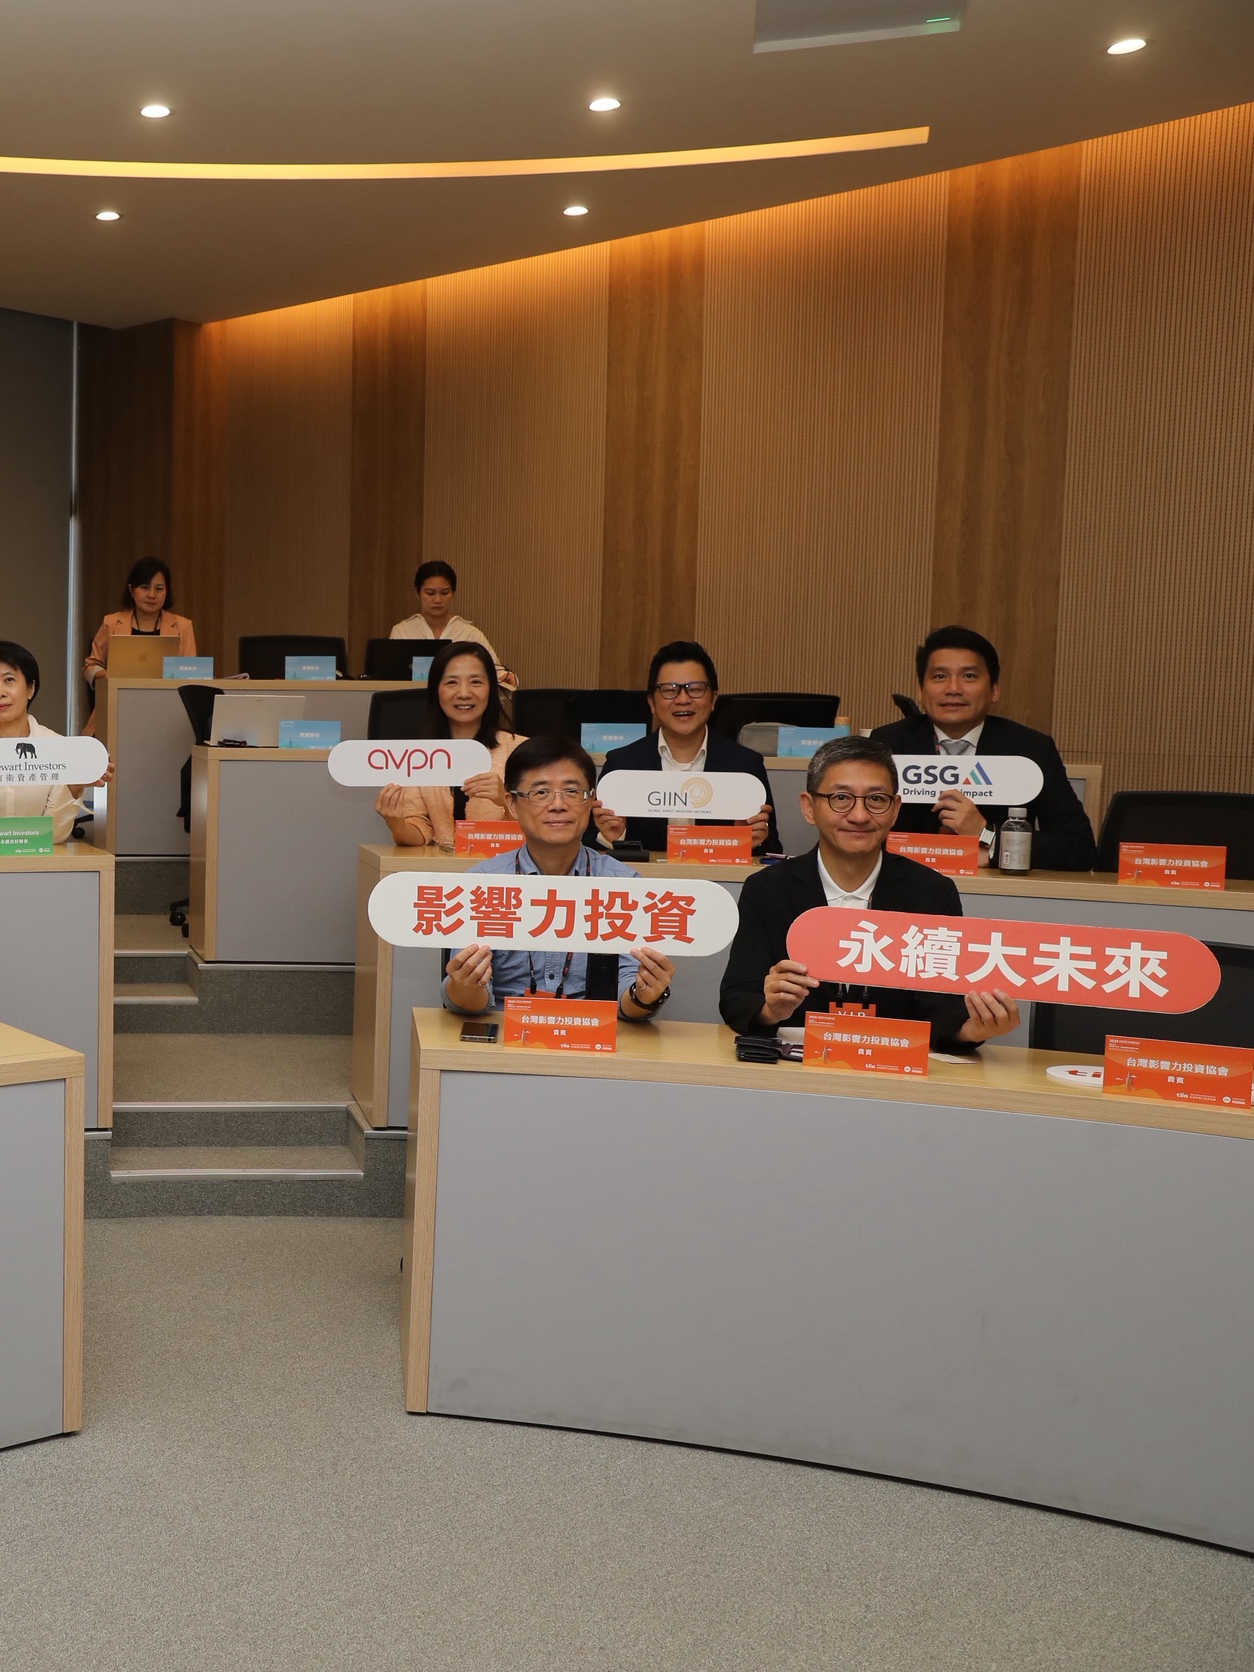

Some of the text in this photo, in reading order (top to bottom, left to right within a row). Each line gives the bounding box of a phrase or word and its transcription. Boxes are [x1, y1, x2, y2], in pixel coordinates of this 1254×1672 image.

[24, 761, 67, 771] Investors
[367, 748, 452, 778] avpn
[902, 765, 960, 785] GSG
[647, 791, 688, 806] GIIN
[902, 788, 936, 798] Driving
[960, 788, 993, 799] impact
[412, 884, 697, 944] 影響力投資
[836, 919, 1171, 999] 永續大未來
[521, 1014, 600, 1027] 台灣影響力投資協會
[823, 1031, 910, 1048] 台灣影響力投資協會
[1126, 1056, 1229, 1077] 台灣影響力投資協會
[1167, 1075, 1184, 1085] 貴賓
